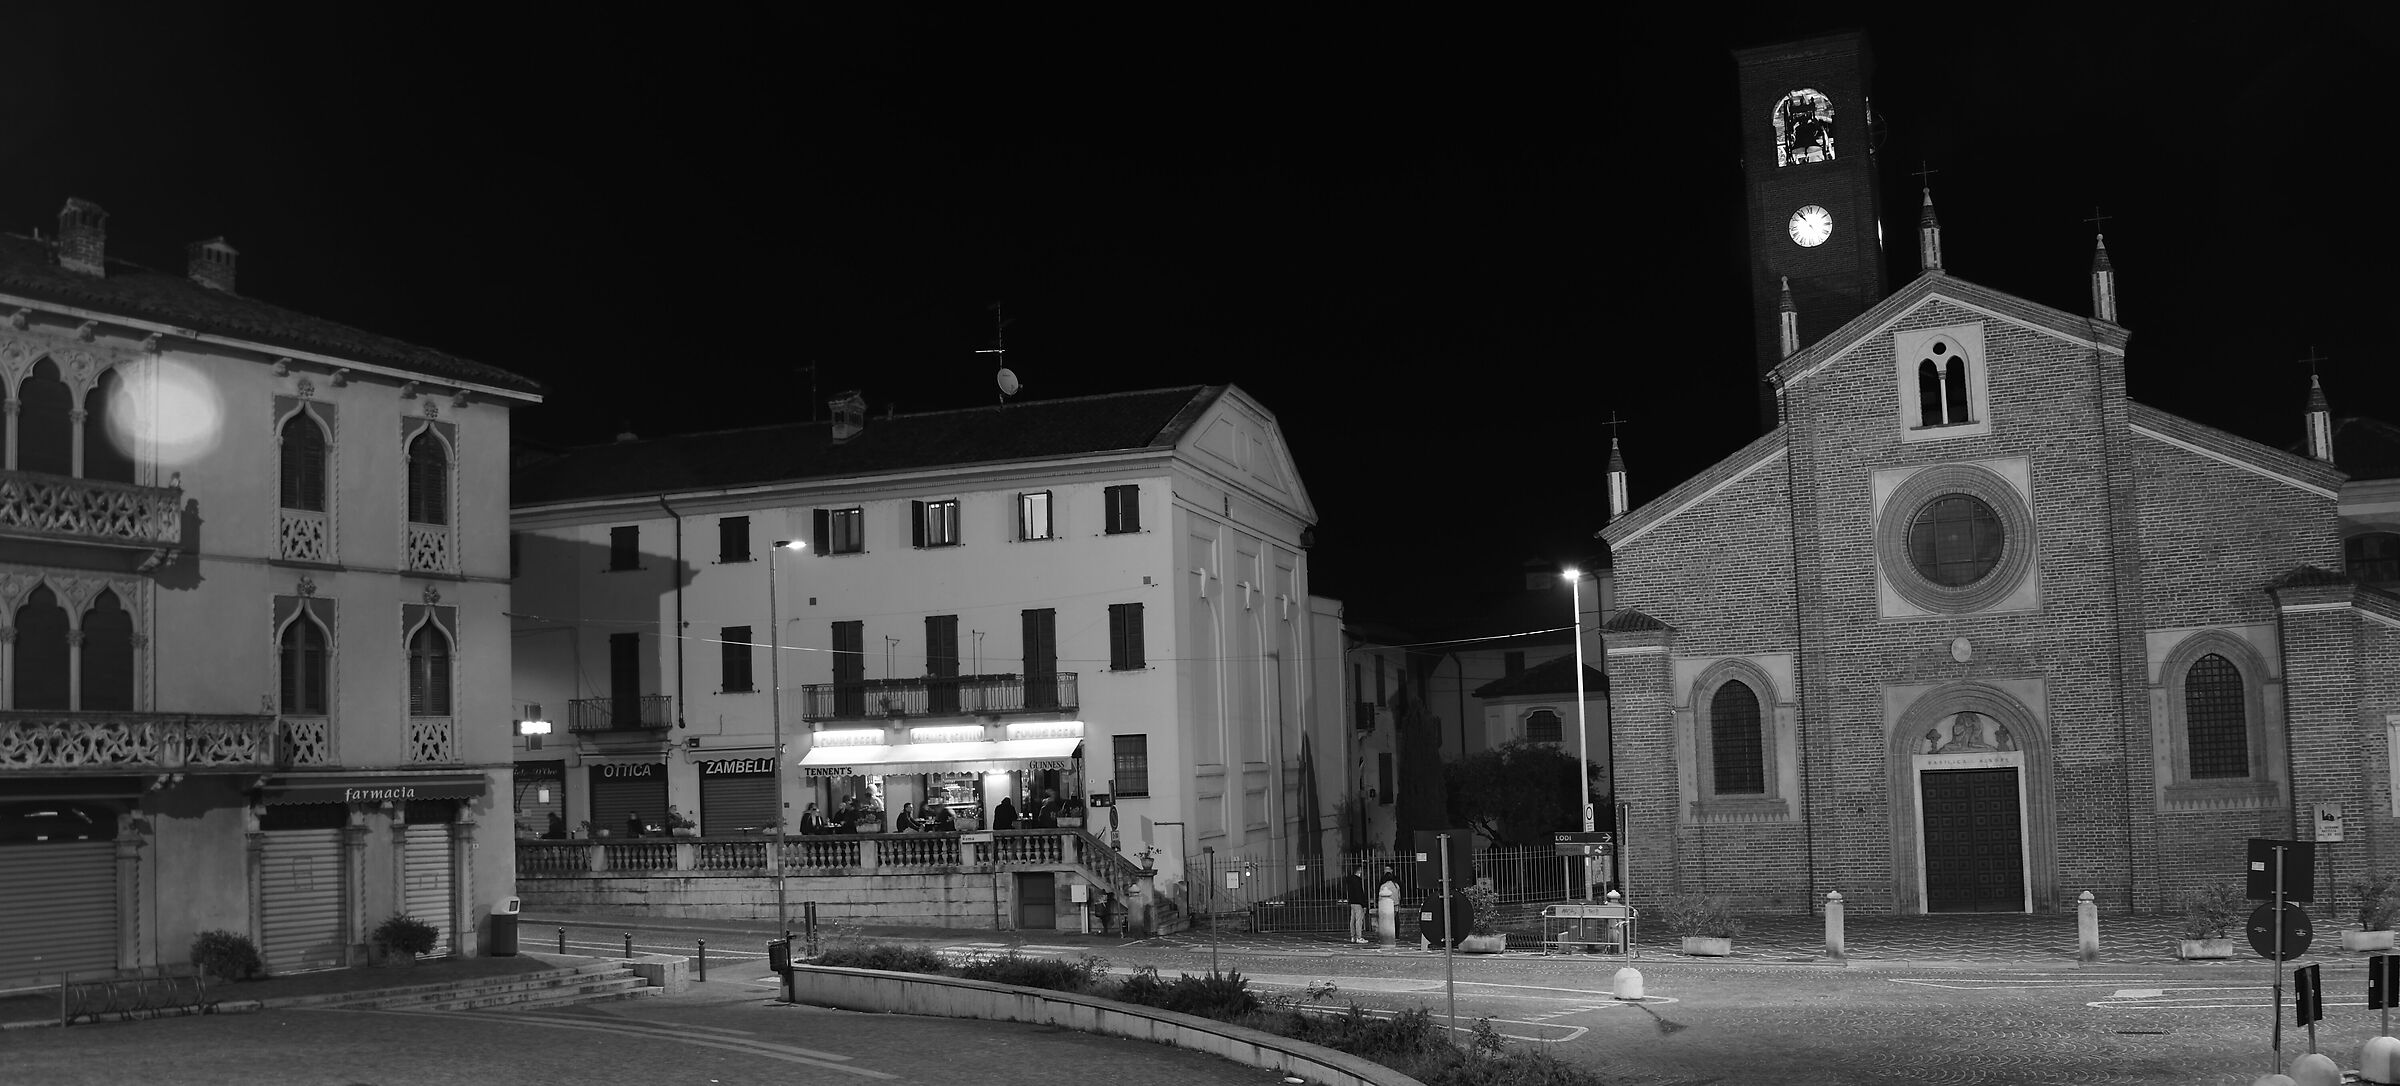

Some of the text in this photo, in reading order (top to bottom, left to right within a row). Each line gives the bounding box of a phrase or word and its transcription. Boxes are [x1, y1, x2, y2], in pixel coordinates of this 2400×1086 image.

[603, 763, 651, 778] OTTICA
[705, 758, 774, 774] ZAMBELLI
[804, 766, 853, 776] TENNENT'S
[1029, 759, 1065, 769] GUINNESS
[345, 786, 415, 802] farmacia
